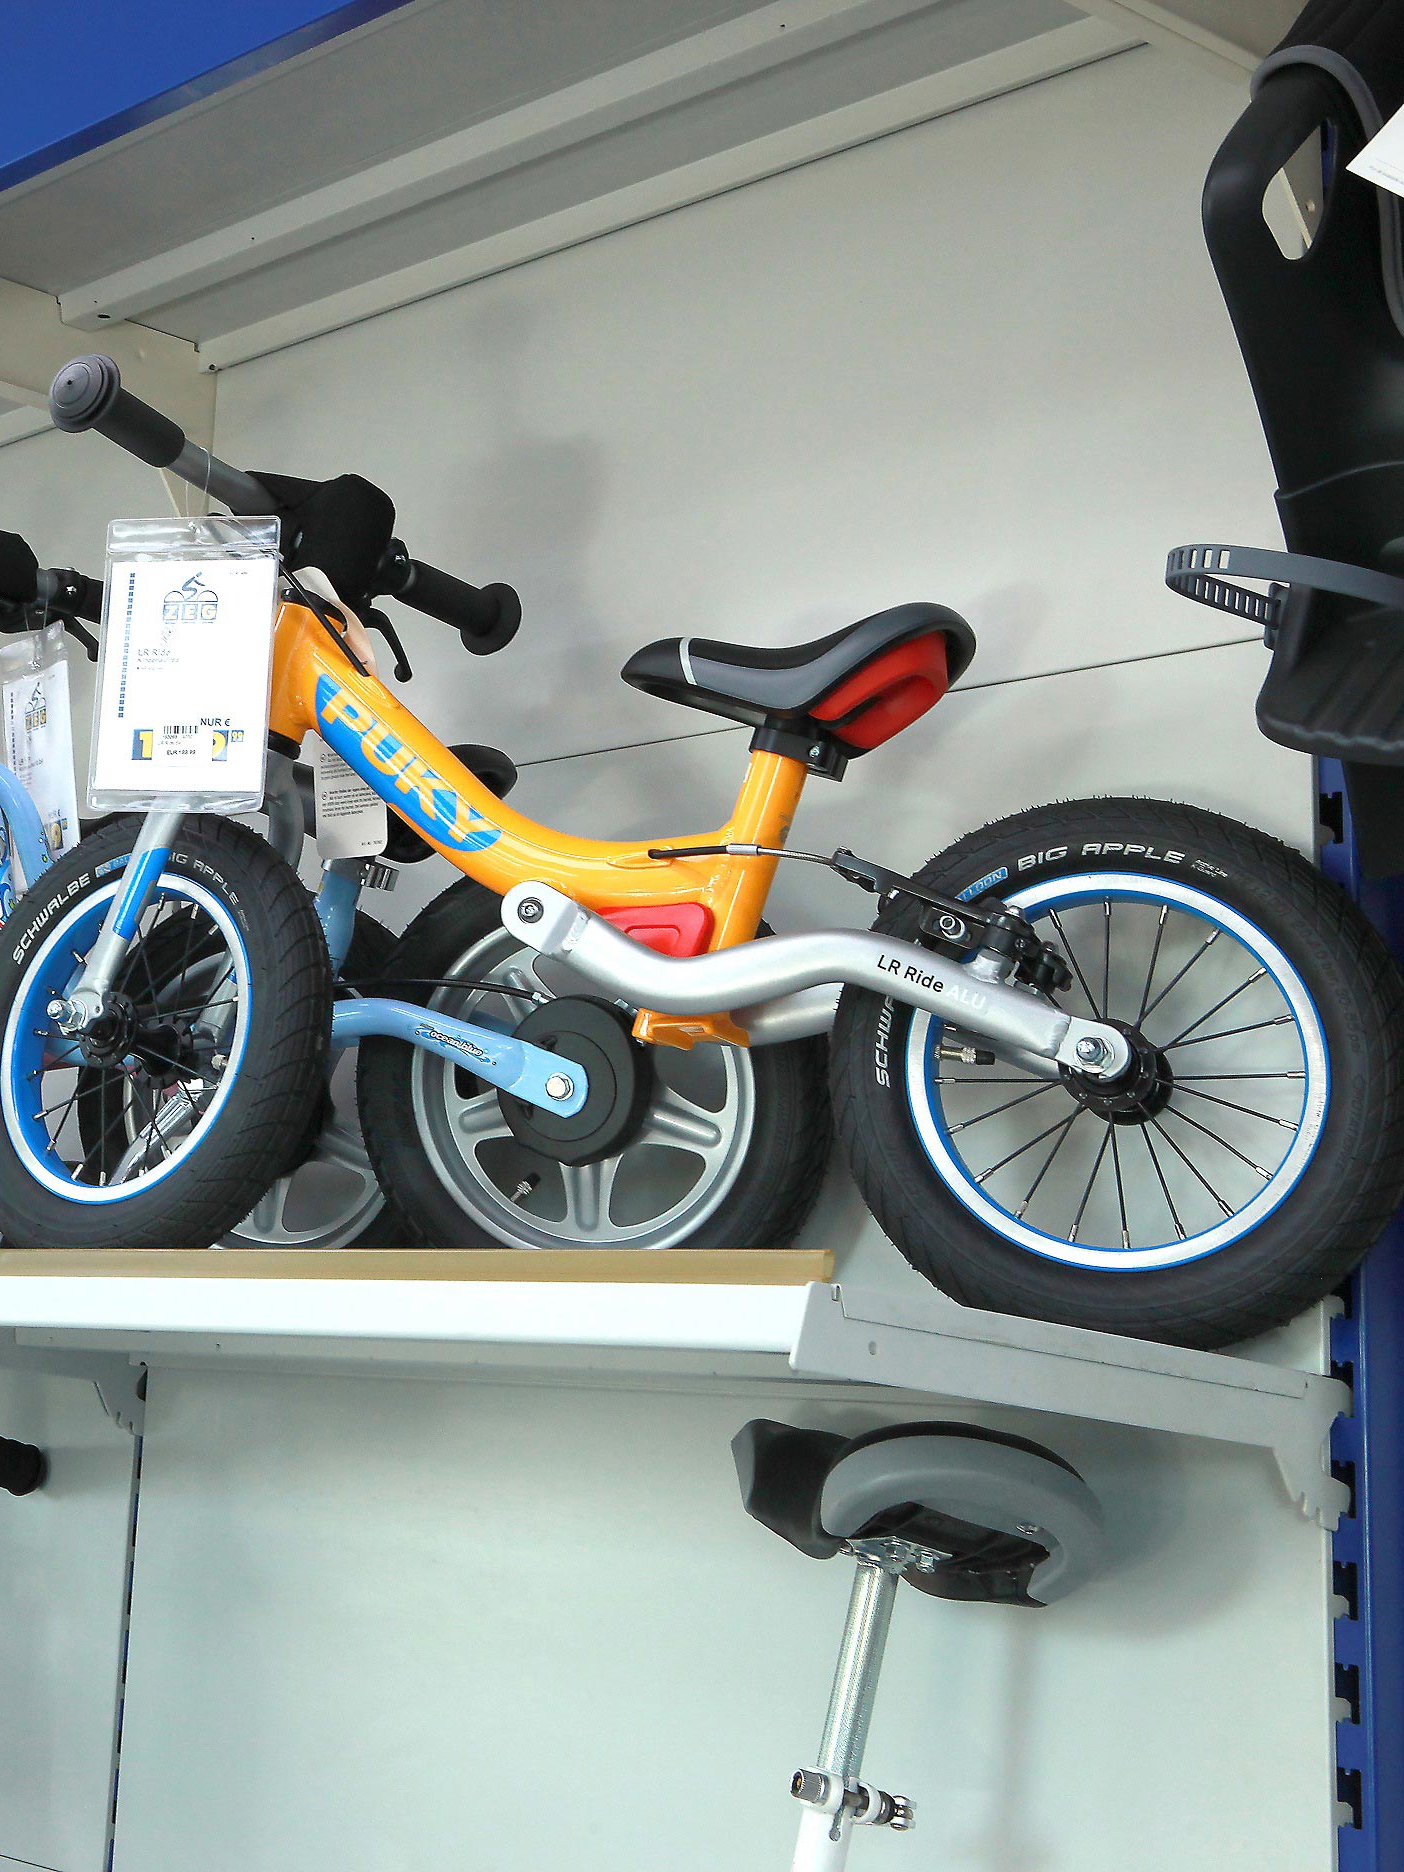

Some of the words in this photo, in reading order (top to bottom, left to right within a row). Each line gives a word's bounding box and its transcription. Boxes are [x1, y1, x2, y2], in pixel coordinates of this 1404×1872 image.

[163, 604, 217, 620] ZEG
[200, 717, 222, 726] NUR
[224, 718, 230, 726] €
[320, 688, 496, 843] PUKY
[167, 851, 188, 865] IG
[193, 859, 239, 905] APPLE
[1018, 846, 1068, 871] BIG
[1082, 842, 1186, 864] APPLE
[12, 872, 91, 965] SCHWALBE
[877, 954, 901, 975] LR
[904, 965, 944, 993] Ride
[946, 984, 987, 1009] ALU
